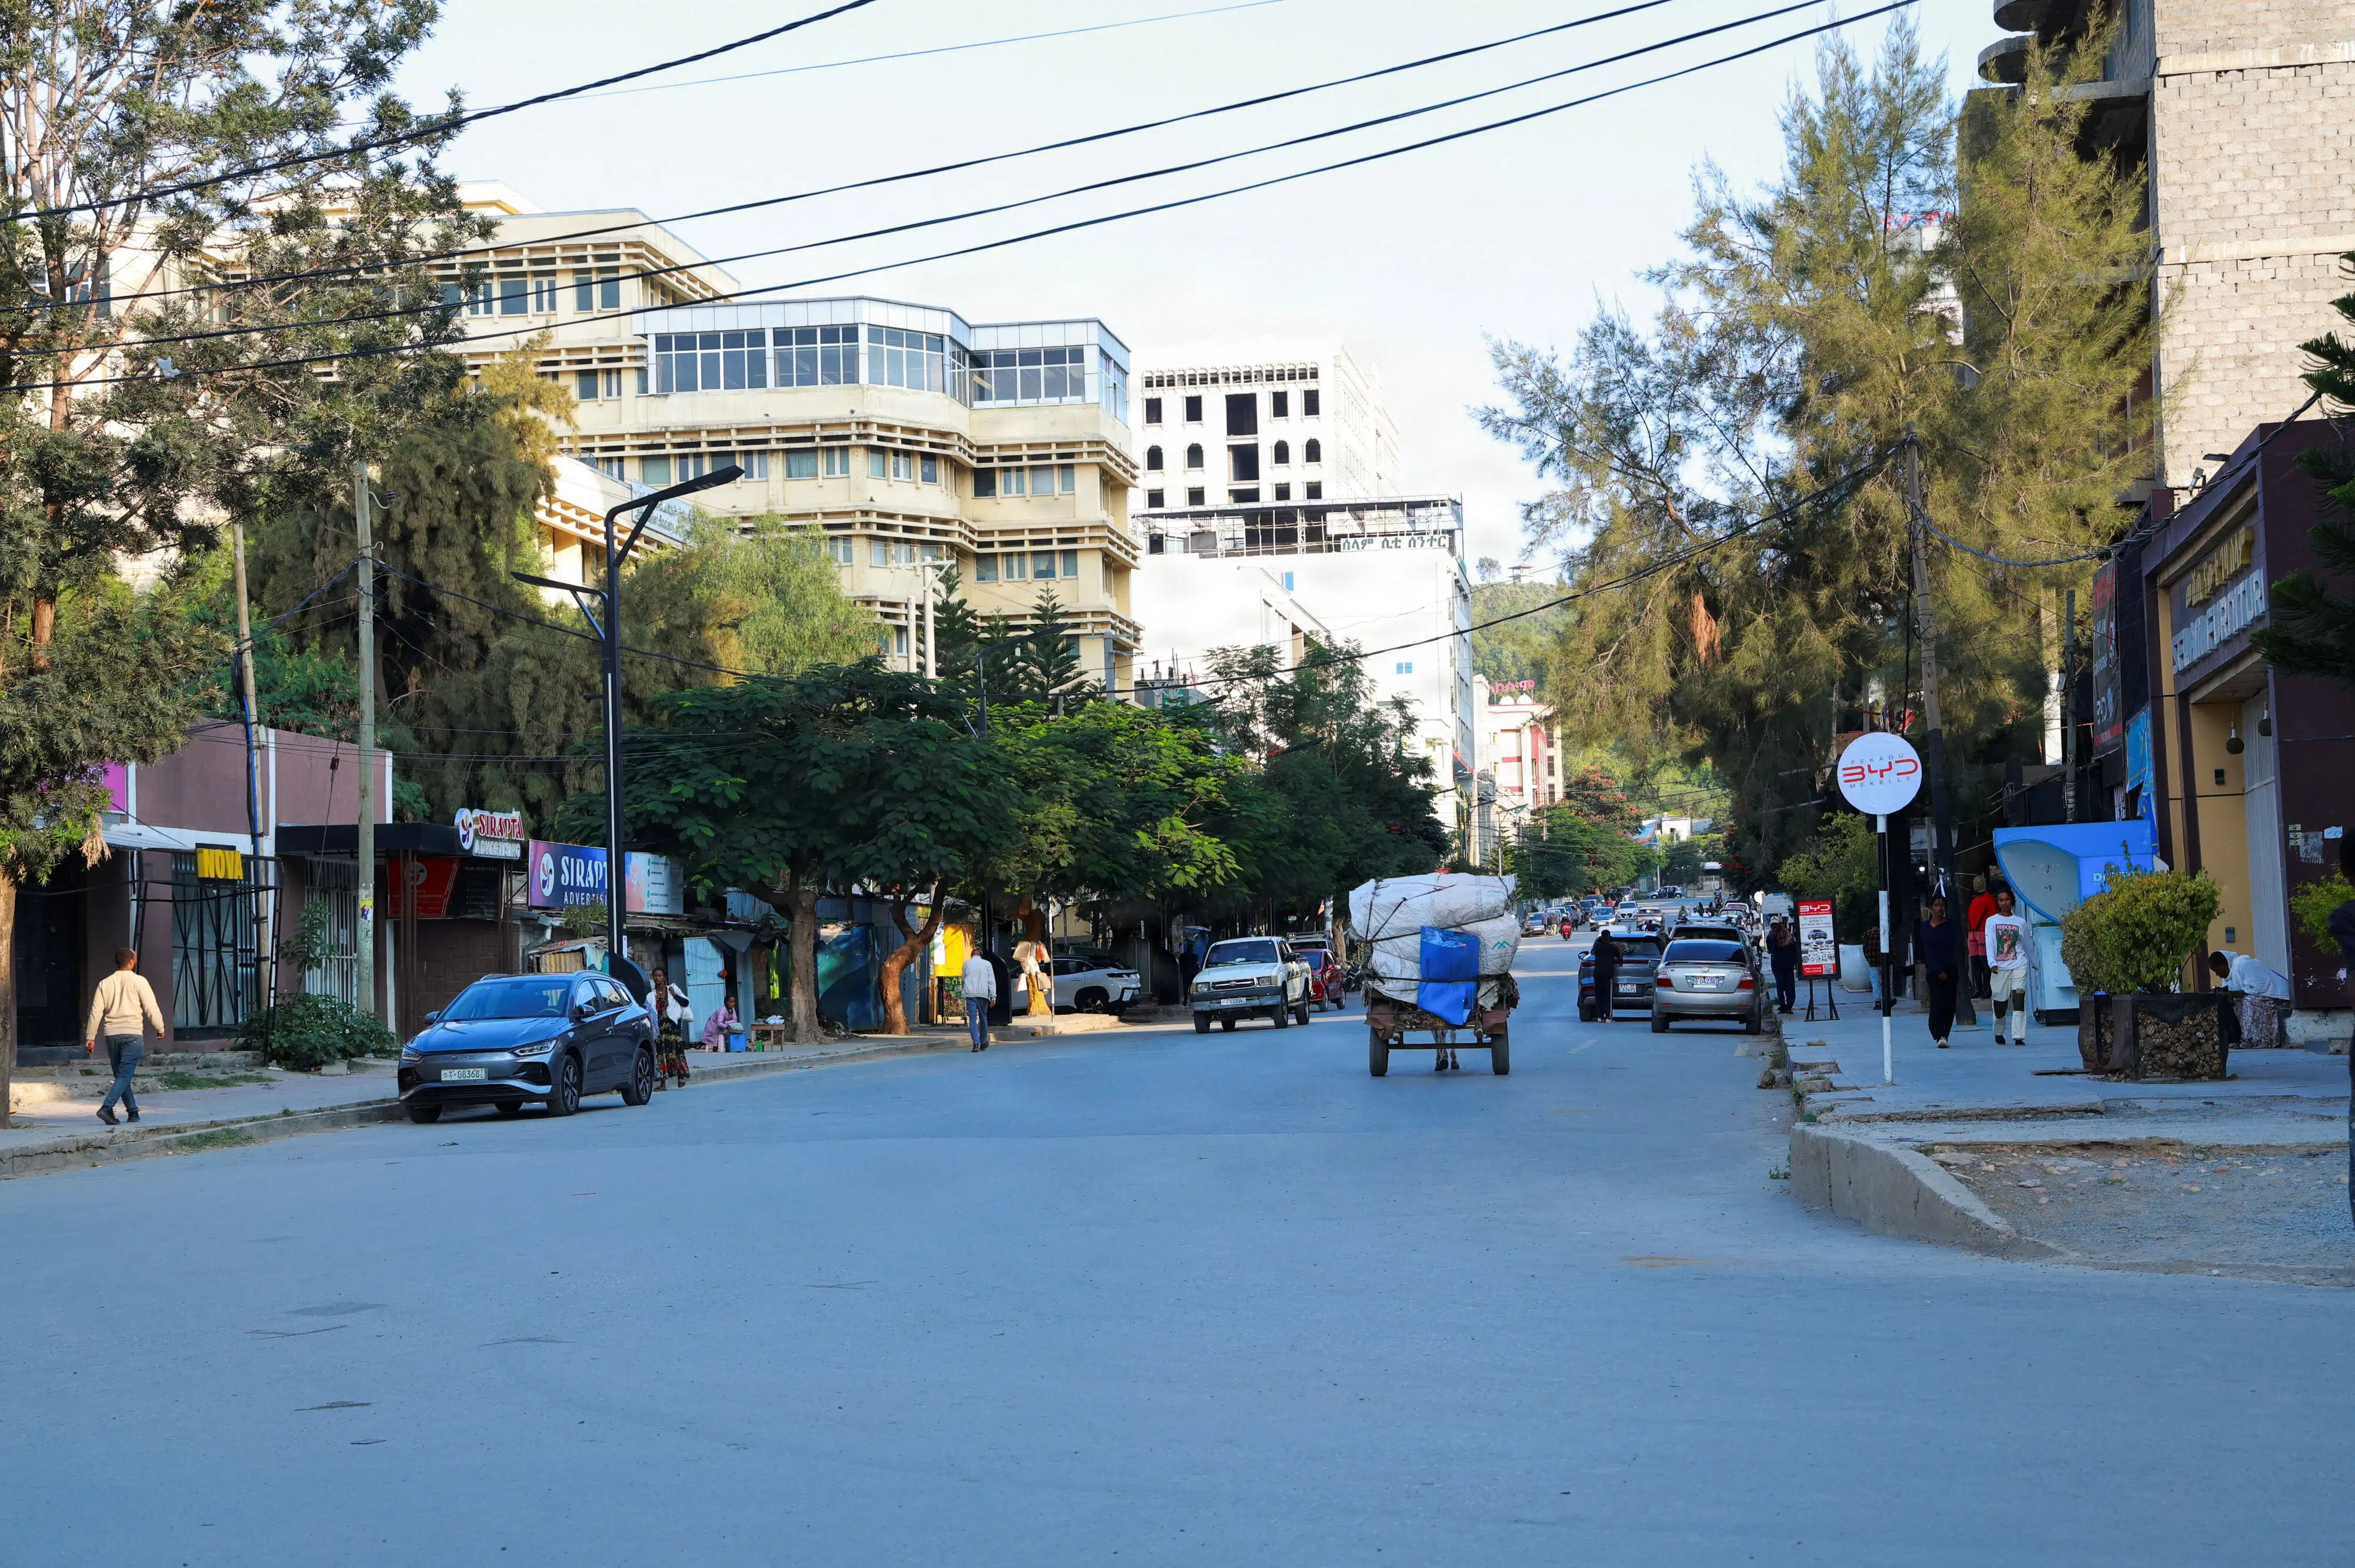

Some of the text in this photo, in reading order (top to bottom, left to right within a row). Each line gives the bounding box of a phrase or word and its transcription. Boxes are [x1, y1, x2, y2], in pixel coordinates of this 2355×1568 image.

[1342, 538, 1374, 550] ሰላም
[2206, 567, 2266, 650] FURNITUR
[1851, 753, 1903, 765] FEKADU
[1842, 759, 1918, 783] BYD
[1850, 776, 1911, 789] MEKELLE
[478, 813, 525, 841] SIRAPTA
[475, 840, 521, 858] ADVERTISING
[197, 848, 244, 880] NOVA
[560, 855, 608, 889] SIRAPT
[1800, 904, 1830, 912] BYD
[457, 1070, 480, 1079] 08368
